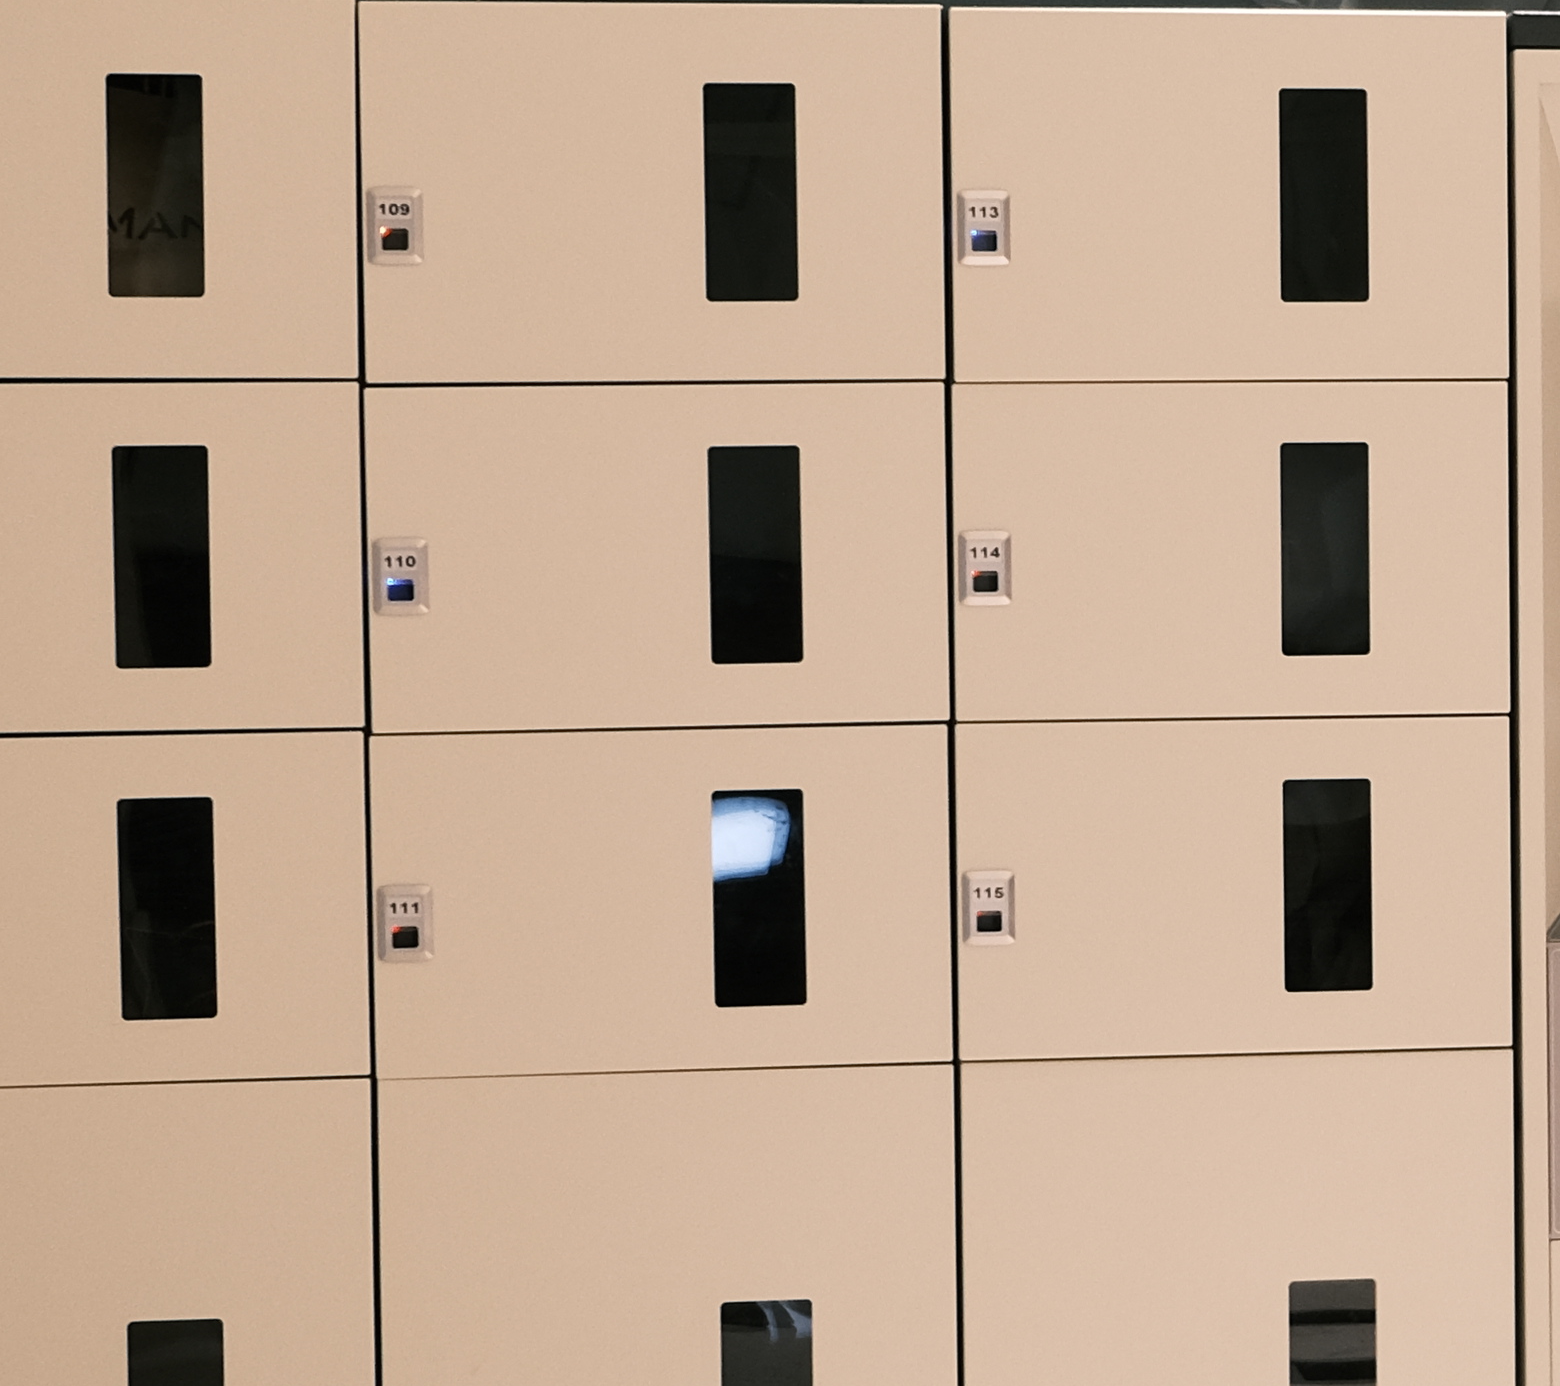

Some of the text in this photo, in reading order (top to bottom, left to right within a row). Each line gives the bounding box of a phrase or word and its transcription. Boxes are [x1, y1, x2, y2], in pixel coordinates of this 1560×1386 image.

[379, 204, 410, 215] 109
[969, 207, 999, 217] 113
[971, 547, 1000, 559] 114
[384, 556, 415, 567] 110
[974, 888, 1004, 899] 115
[390, 903, 419, 913] 111
